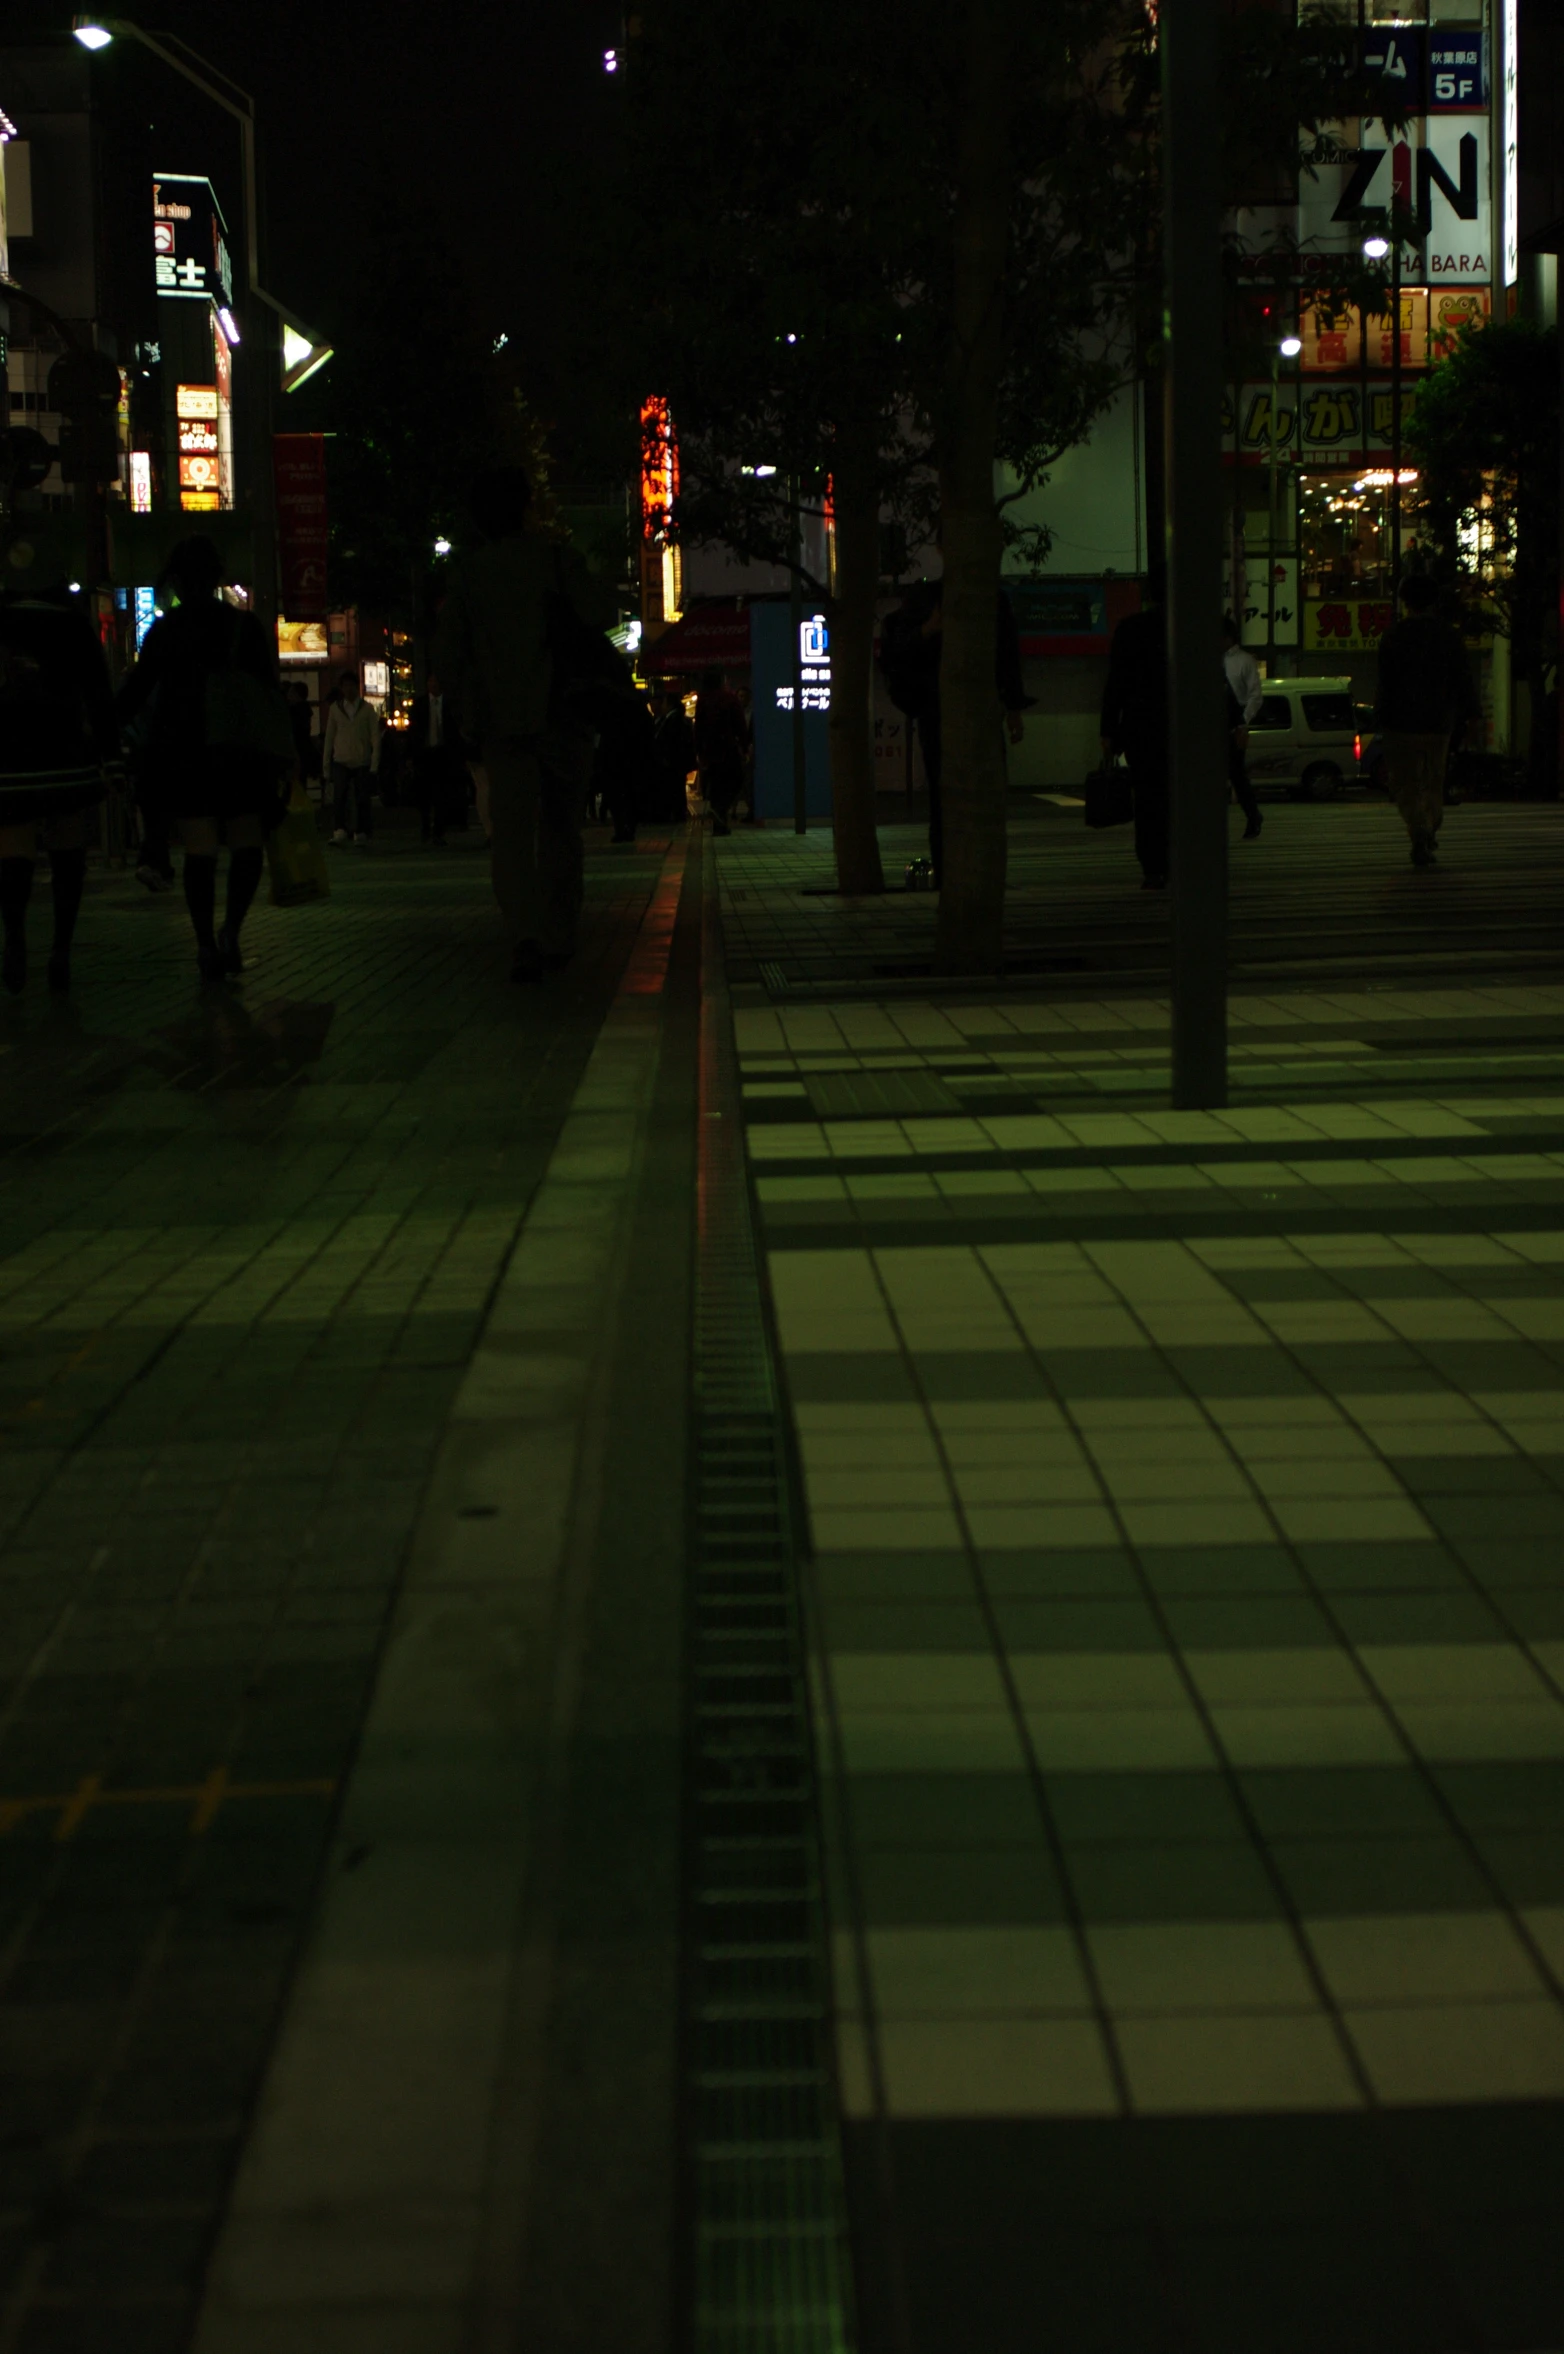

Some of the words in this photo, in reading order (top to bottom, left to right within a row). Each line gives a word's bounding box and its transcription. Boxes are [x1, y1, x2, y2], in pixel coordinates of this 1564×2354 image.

[1431, 51, 1478, 65] 秋葉原店
[1435, 73, 1473, 100] 5F
[1331, 131, 1478, 237] ZIN
[1365, 254, 1487, 273] AKHABARA
[684, 623, 749, 636] docomo
